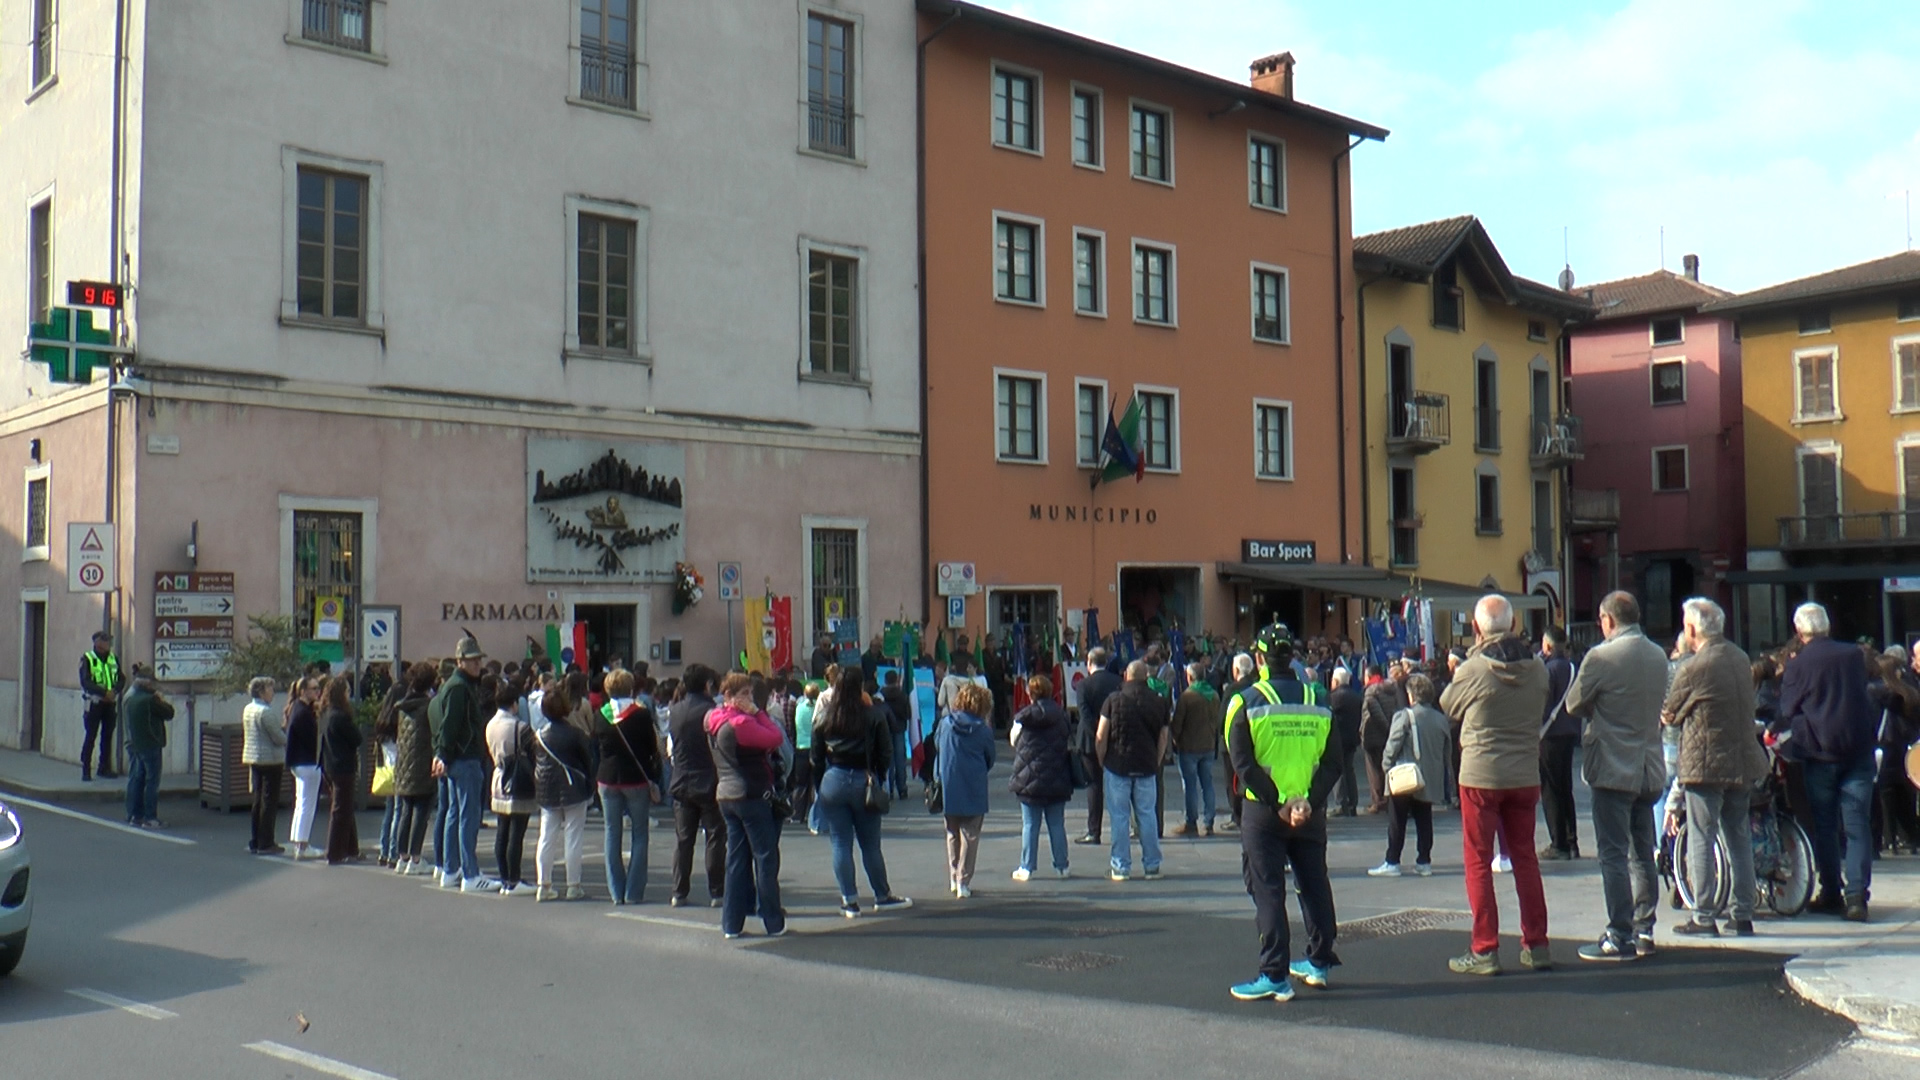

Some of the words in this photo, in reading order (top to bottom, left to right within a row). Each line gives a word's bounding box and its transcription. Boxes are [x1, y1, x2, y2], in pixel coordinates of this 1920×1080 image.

[1029, 503, 1157, 524] MUNICIPIO
[1250, 541, 1276, 558] Bar
[1278, 542, 1312, 561] Sport
[85, 568, 98, 581] 30
[157, 596, 183, 605] centro
[157, 605, 189, 616] sportivo
[441, 602, 560, 621] FARMACIA
